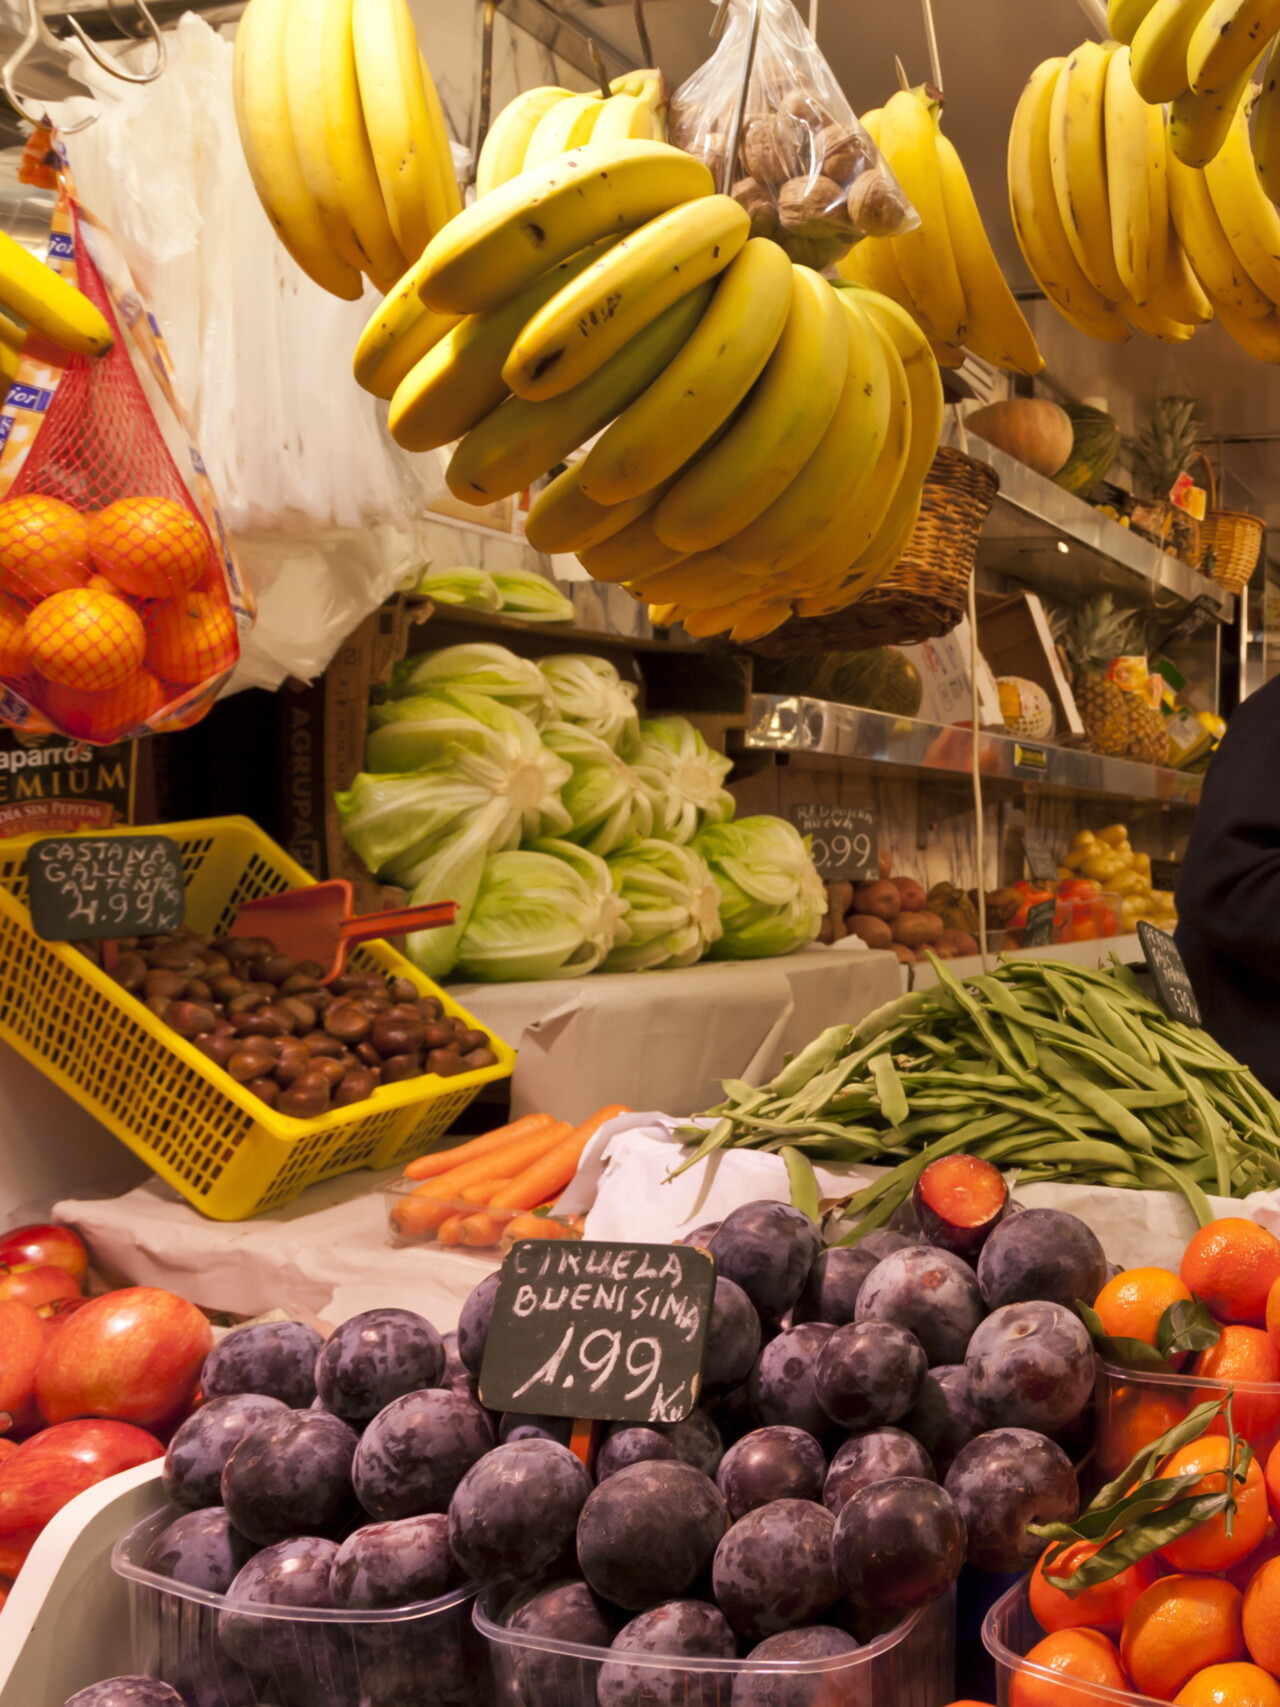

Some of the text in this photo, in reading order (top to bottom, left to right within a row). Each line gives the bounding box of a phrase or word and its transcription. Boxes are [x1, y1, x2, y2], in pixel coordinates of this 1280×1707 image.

[45, 860, 177, 883] GALLEGA
[67, 892, 155, 925] 4.99
[514, 1243, 683, 1289] CIRUELA
[512, 1282, 700, 1343] BUENISIMA
[512, 1321, 663, 1401] 1.99
